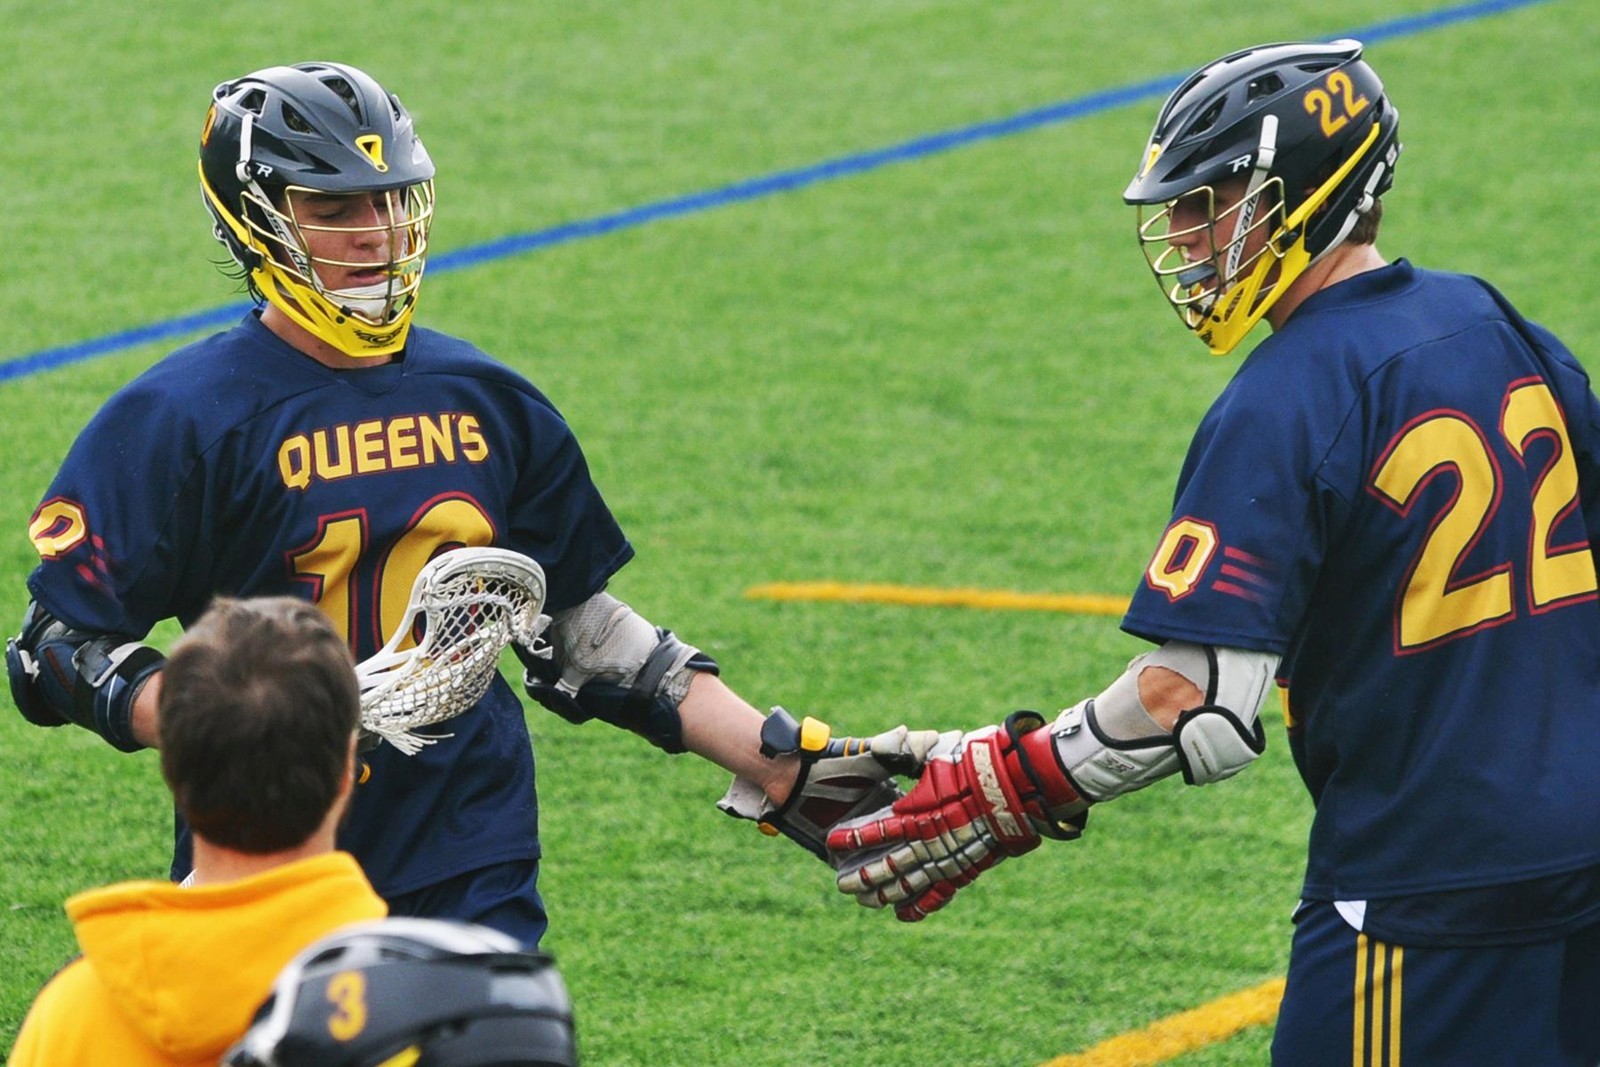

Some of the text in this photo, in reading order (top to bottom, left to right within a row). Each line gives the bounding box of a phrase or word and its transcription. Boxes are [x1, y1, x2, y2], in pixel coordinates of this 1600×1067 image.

[1302, 70, 1371, 138] 22
[255, 194, 311, 278] cascde
[278, 412, 489, 490] QUEEN'S
[28, 496, 89, 560] Q
[1366, 376, 1599, 656] 22
[1146, 516, 1219, 603] Q
[970, 742, 1024, 837] BRINE
[326, 970, 368, 1042] 3
